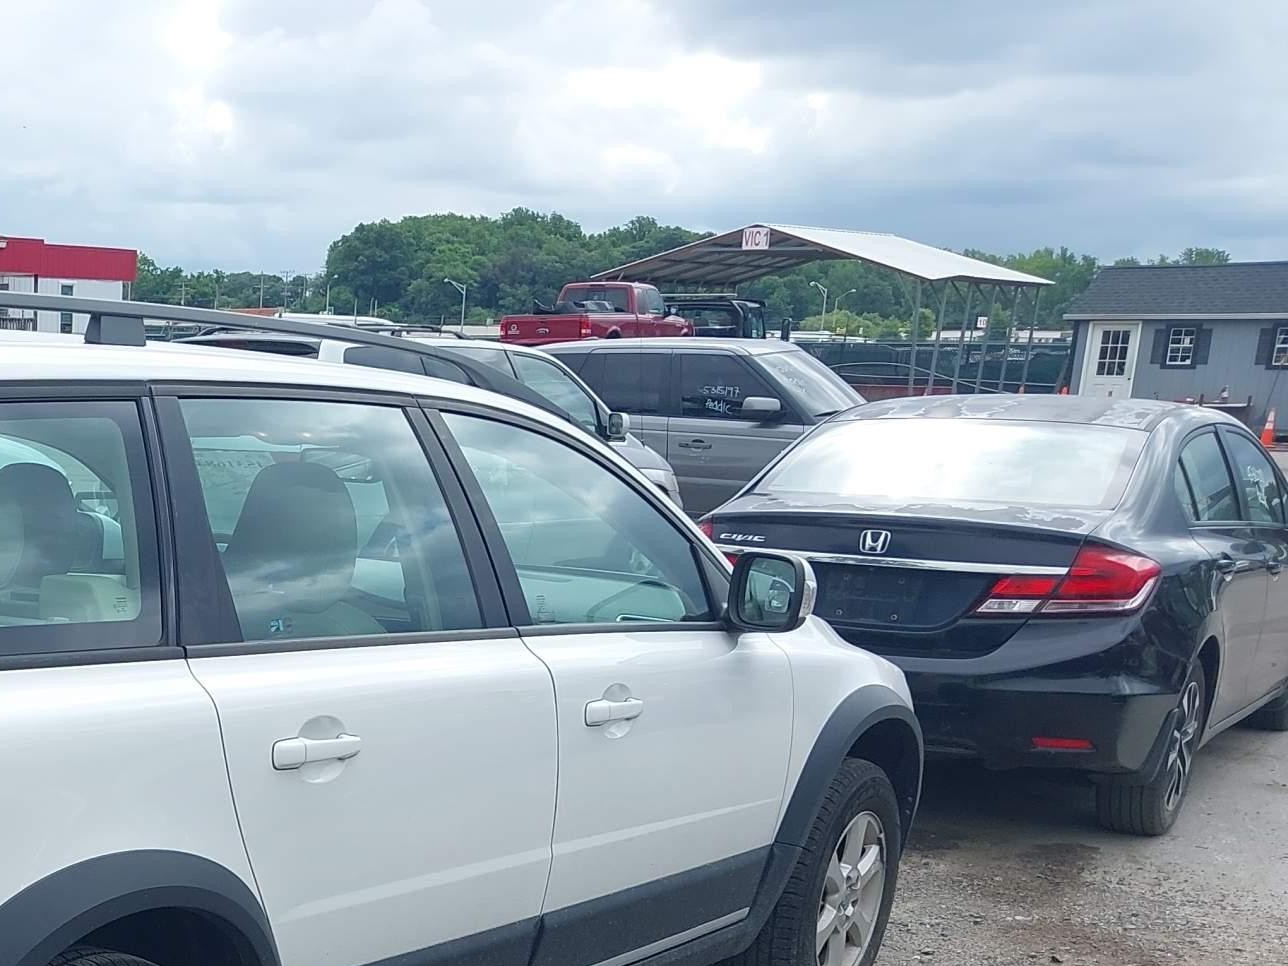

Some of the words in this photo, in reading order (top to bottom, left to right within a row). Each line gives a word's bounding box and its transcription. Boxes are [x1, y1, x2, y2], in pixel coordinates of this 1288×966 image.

[744, 230, 761, 247] VIC
[763, 230, 770, 247] 1
[719, 532, 766, 542] CIVIC
